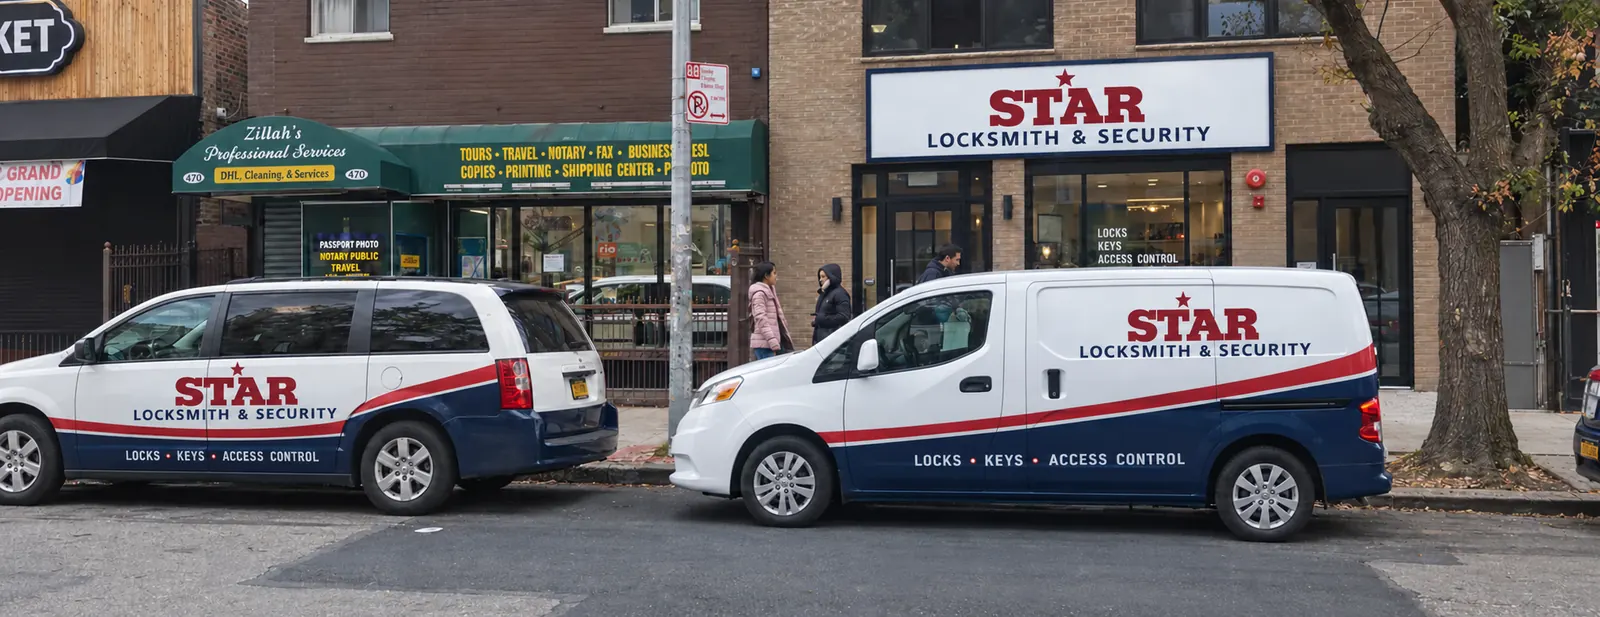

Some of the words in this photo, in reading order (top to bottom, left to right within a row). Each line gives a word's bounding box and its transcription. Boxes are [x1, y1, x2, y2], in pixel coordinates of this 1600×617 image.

[989, 86, 1145, 127] STAR
[244, 125, 301, 141] Zillah's
[927, 130, 1059, 148] LOCKSMITH
[1072, 130, 1088, 145] &
[1098, 126, 1211, 145] SECURITY
[204, 145, 290, 164] Professional
[292, 144, 346, 159] Services
[460, 147, 492, 161] TOURS
[502, 146, 538, 160] TRAVEL
[548, 145, 586, 160] NOTARY
[596, 145, 613, 159] FAX
[628, 144, 673, 159] BUSINES
[691, 143, 709, 158] ESL
[7, 164, 61, 181] GRAND
[220, 171, 242, 181] DHL,
[286, 171, 293, 179] &
[294, 169, 330, 179] Services
[348, 170, 366, 179] 470
[461, 164, 496, 179] COPIES
[505, 164, 552, 178] PRINTING
[562, 163, 612, 177] SHIPPING
[617, 162, 654, 176] CENTER
[185, 173, 202, 182] 470
[1097, 228, 1127, 238] LOCKS
[320, 241, 354, 249] PASSPORT
[355, 240, 379, 248] PHOTO
[1098, 241, 1121, 251] KEYS
[320, 252, 348, 260] NOTARY
[350, 251, 379, 260] PUBLIC
[1098, 254, 1132, 264] ACCESS
[1137, 253, 1178, 264] CONTROL
[331, 263, 361, 272] TRAVEL
[1127, 308, 1259, 342] STAR
[1080, 345, 1190, 358] LOCKSMITH
[1200, 345, 1211, 357] &
[1219, 342, 1311, 357] SECURITY
[175, 376, 298, 406] STAR
[134, 409, 229, 421] LOCKSMITH
[238, 409, 248, 420] &
[256, 407, 337, 420] SECURITY
[125, 450, 160, 460] LOCKS
[177, 451, 205, 461] KEYS
[222, 451, 264, 461] ACCESS
[270, 451, 319, 462] CONTROL
[914, 454, 962, 466] LOCKS
[984, 454, 1024, 466] KEYS
[1049, 454, 1107, 466] ACCESS
[1116, 453, 1185, 465] CONTROL
